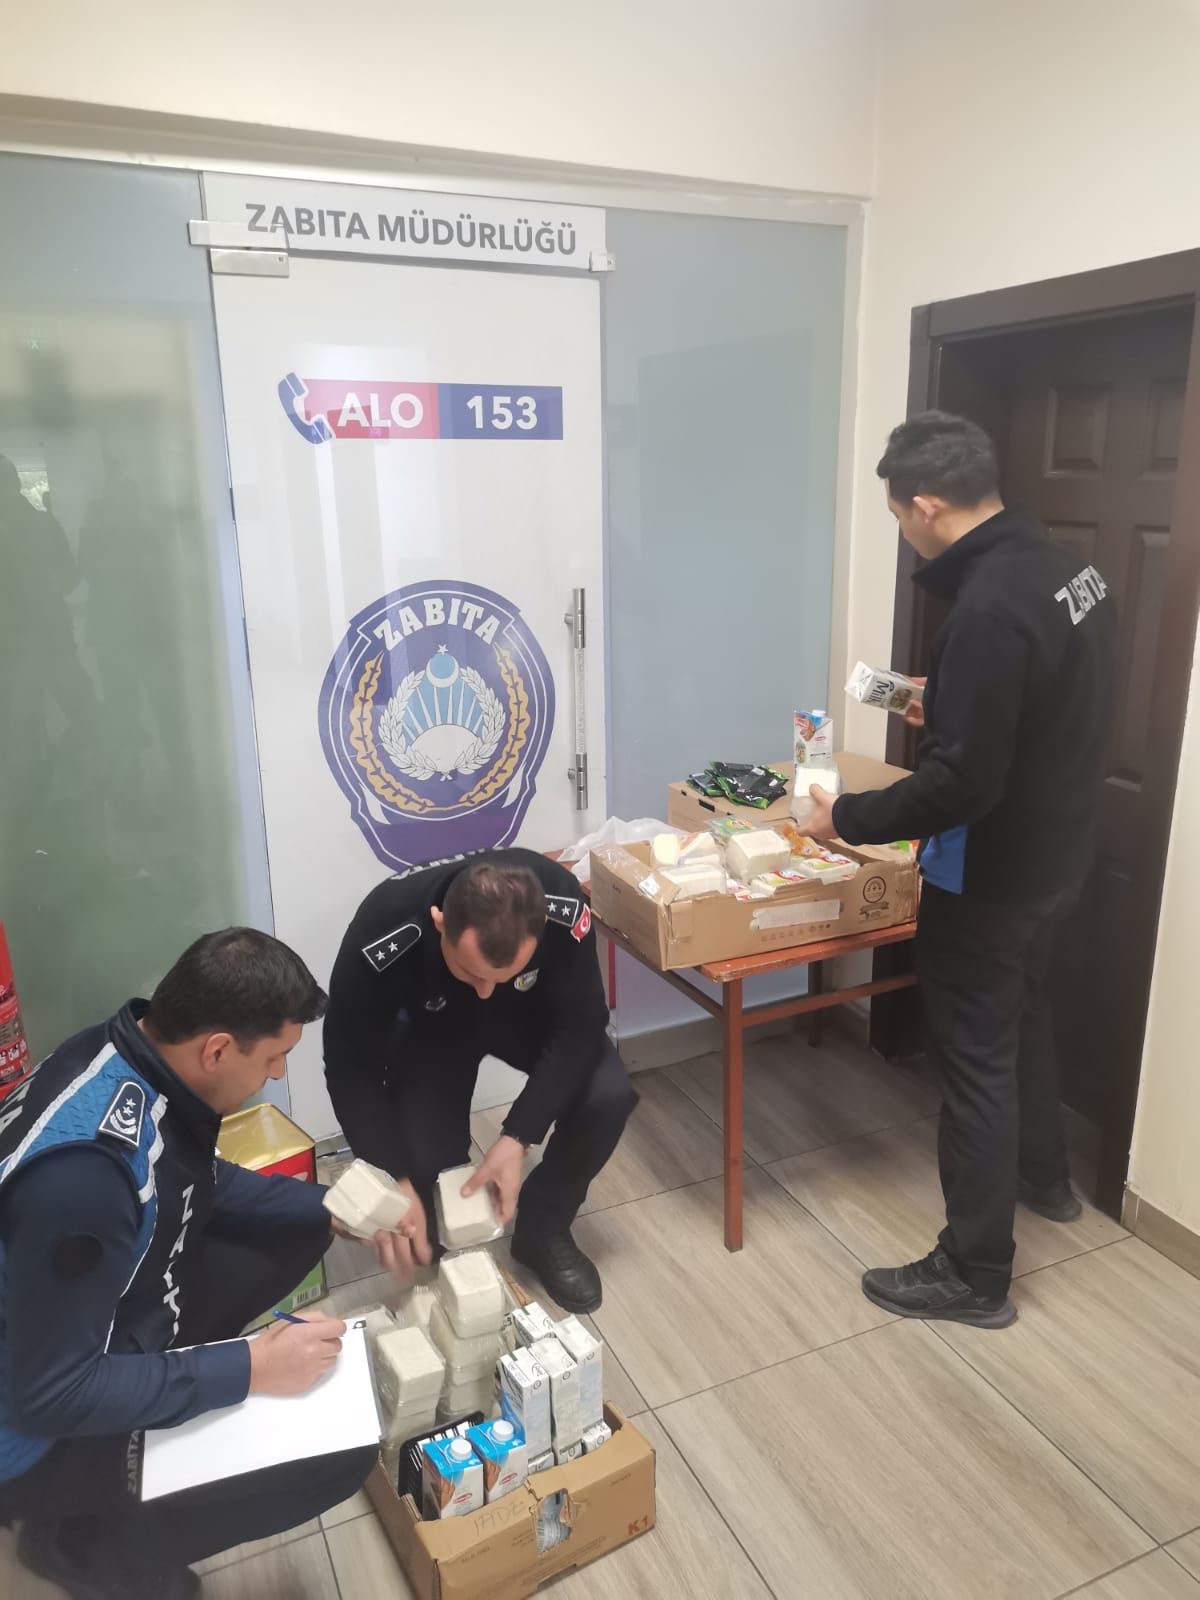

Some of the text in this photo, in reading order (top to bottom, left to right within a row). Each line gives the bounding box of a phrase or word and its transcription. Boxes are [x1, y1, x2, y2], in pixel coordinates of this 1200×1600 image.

[245, 202, 577, 256] ZABITA MÜDÜRLÜĞÜ
[337, 391, 538, 431] ALO 153
[374, 598, 501, 651] ZABITA
